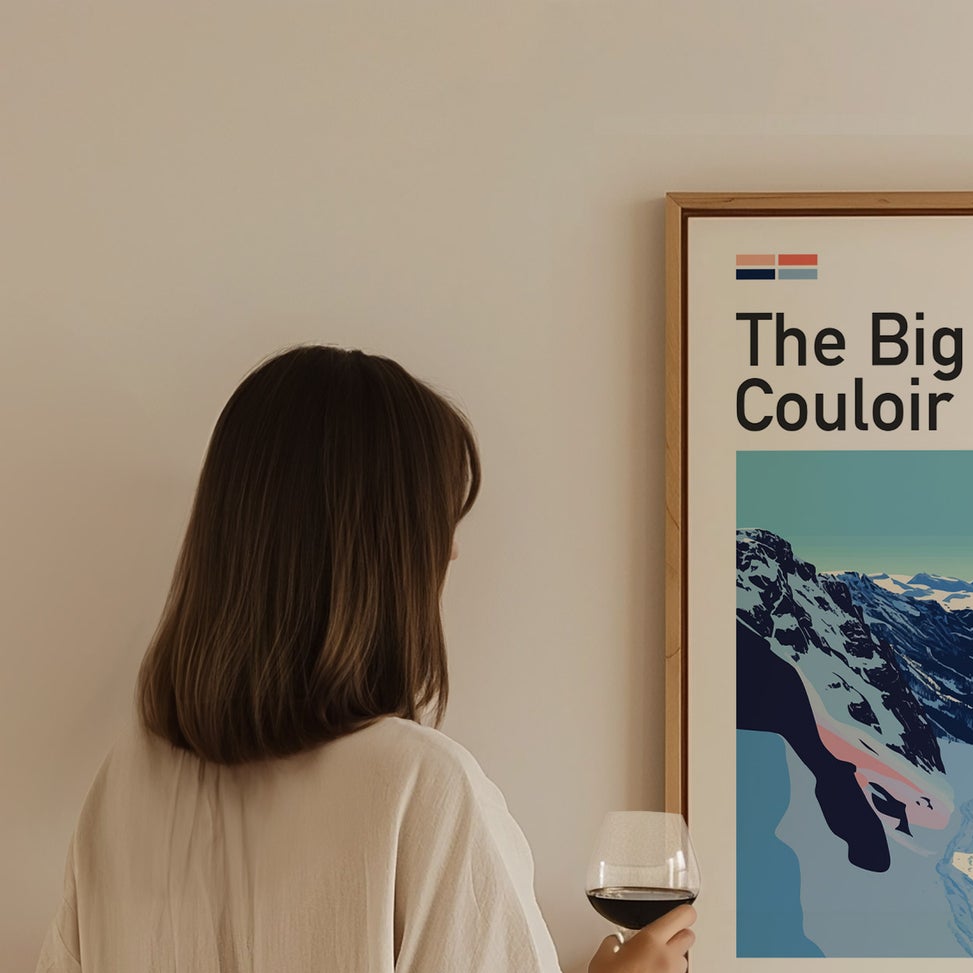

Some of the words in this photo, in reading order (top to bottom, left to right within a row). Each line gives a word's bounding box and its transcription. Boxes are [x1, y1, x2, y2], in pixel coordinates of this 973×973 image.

[736, 312, 846, 366] The
[872, 312, 964, 381] Big
[736, 377, 954, 432] Couloir
